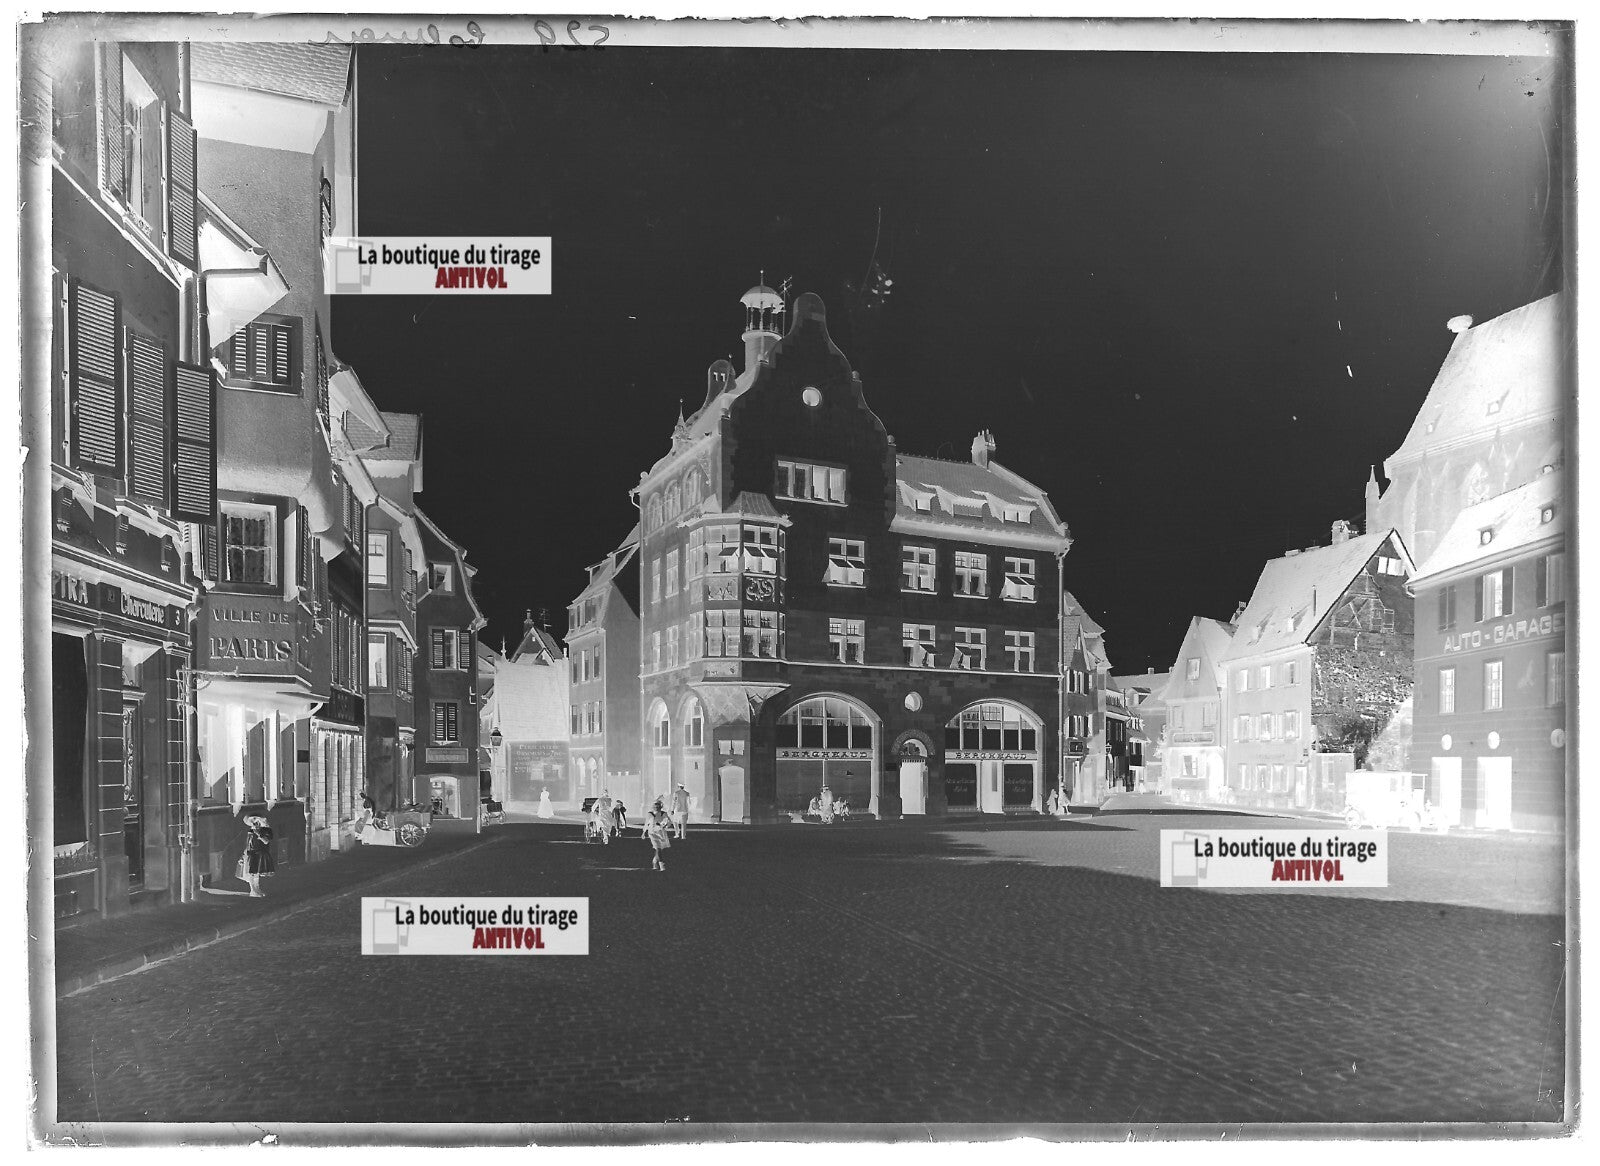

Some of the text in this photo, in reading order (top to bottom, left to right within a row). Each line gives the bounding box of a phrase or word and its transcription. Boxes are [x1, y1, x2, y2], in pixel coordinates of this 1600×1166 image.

[120, 592, 165, 624] Charcuterie
[212, 608, 290, 625] VILLE DE
[1443, 630, 1482, 653] AUTO
[1493, 612, 1565, 645] GARAGE
[209, 637, 293, 662] PARIS
[781, 750, 868, 759] BERGHEAUD
